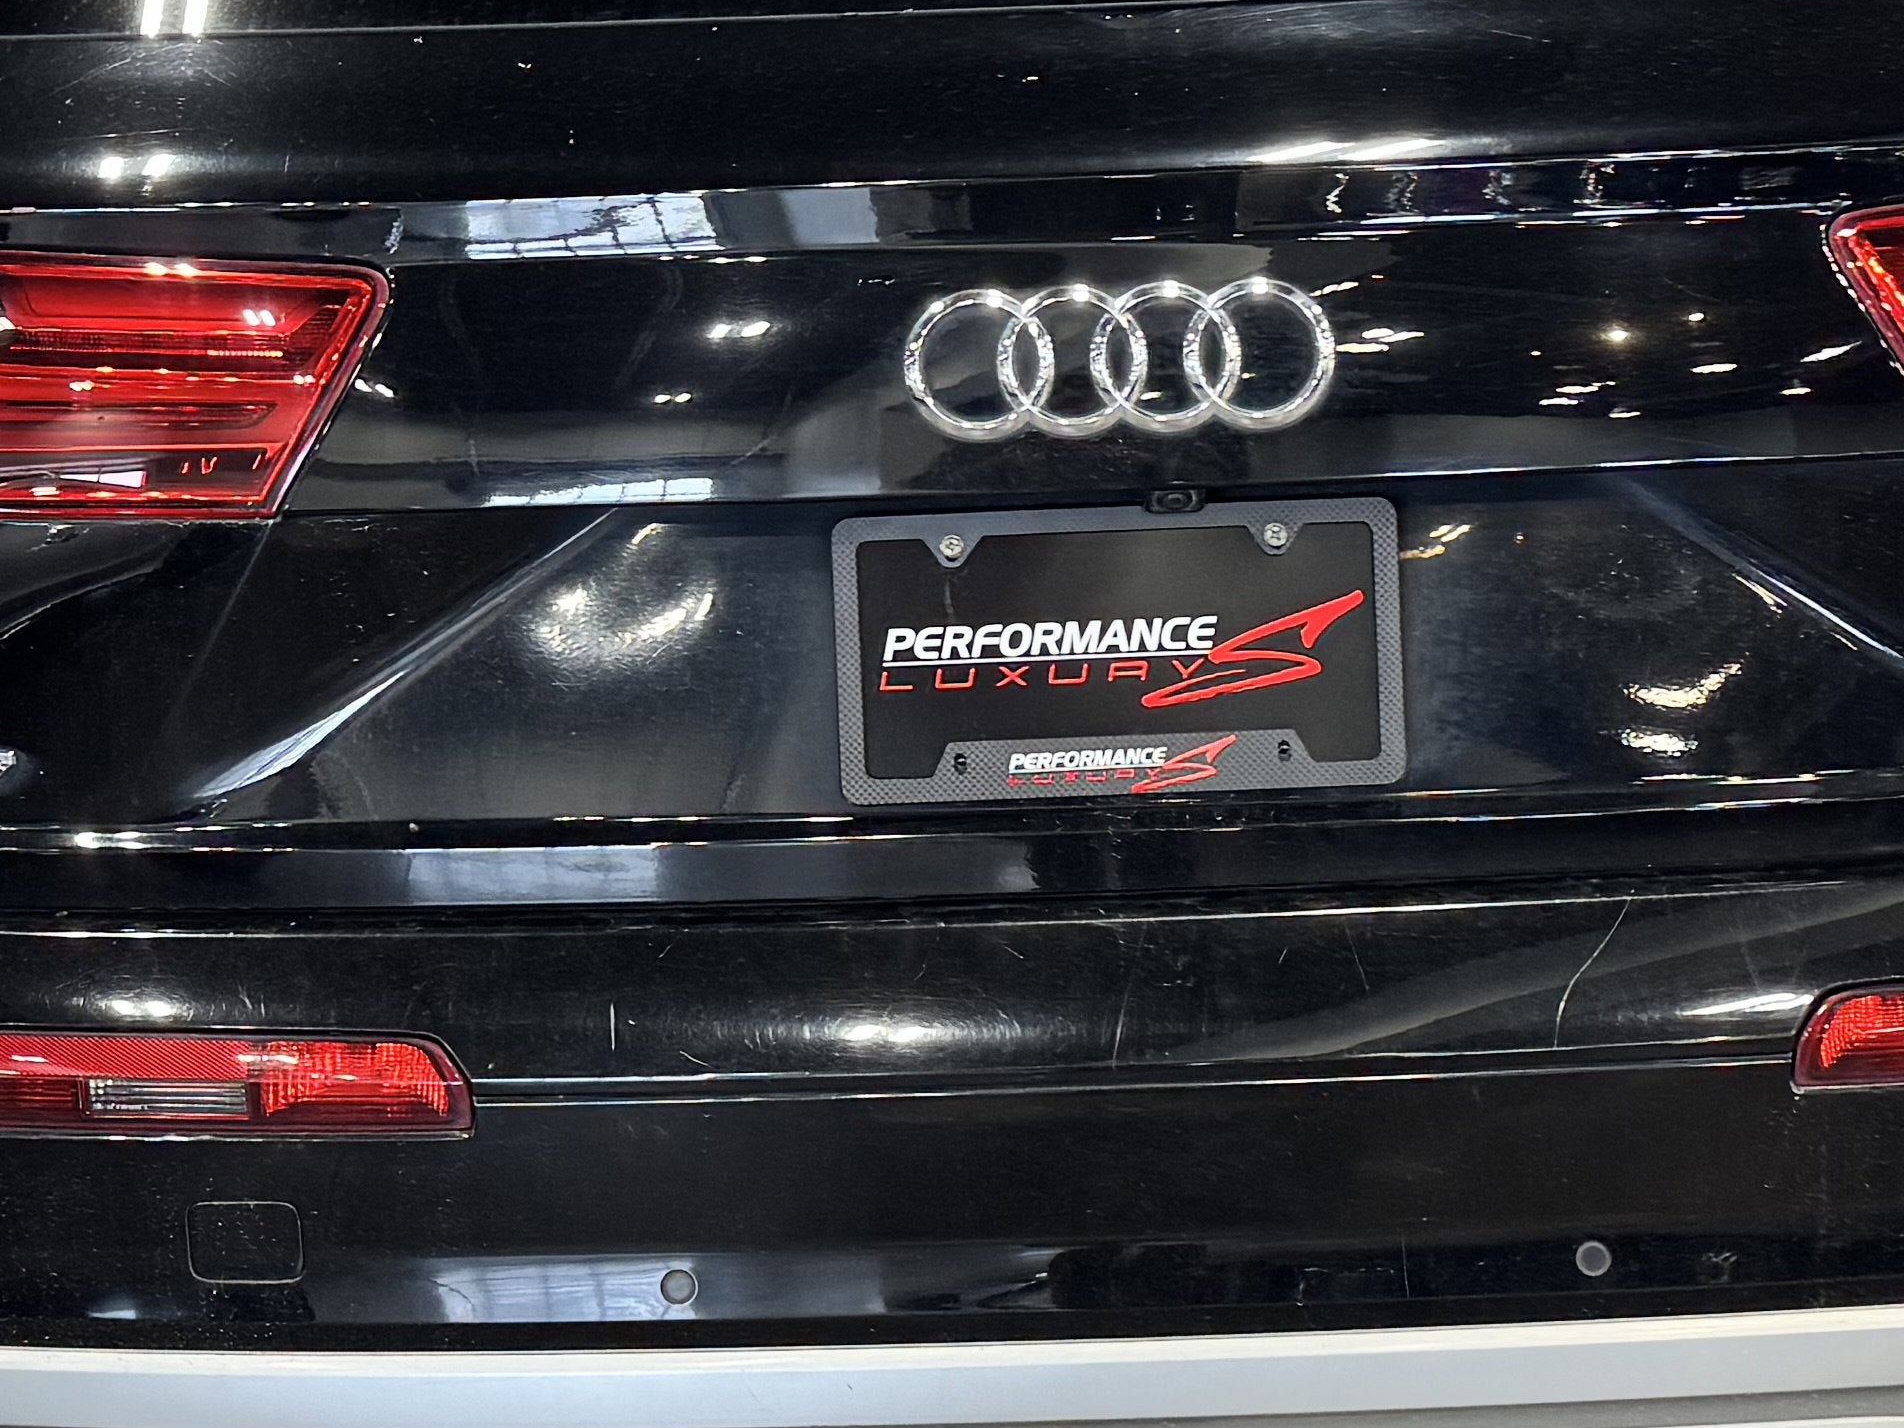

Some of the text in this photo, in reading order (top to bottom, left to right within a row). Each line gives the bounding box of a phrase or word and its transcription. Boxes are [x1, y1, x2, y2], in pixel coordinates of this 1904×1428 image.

[882, 615, 1218, 662] PERFORMANCE
[880, 658, 1205, 692] LUXURY
[1008, 746, 1169, 771] PERFORMANCE
